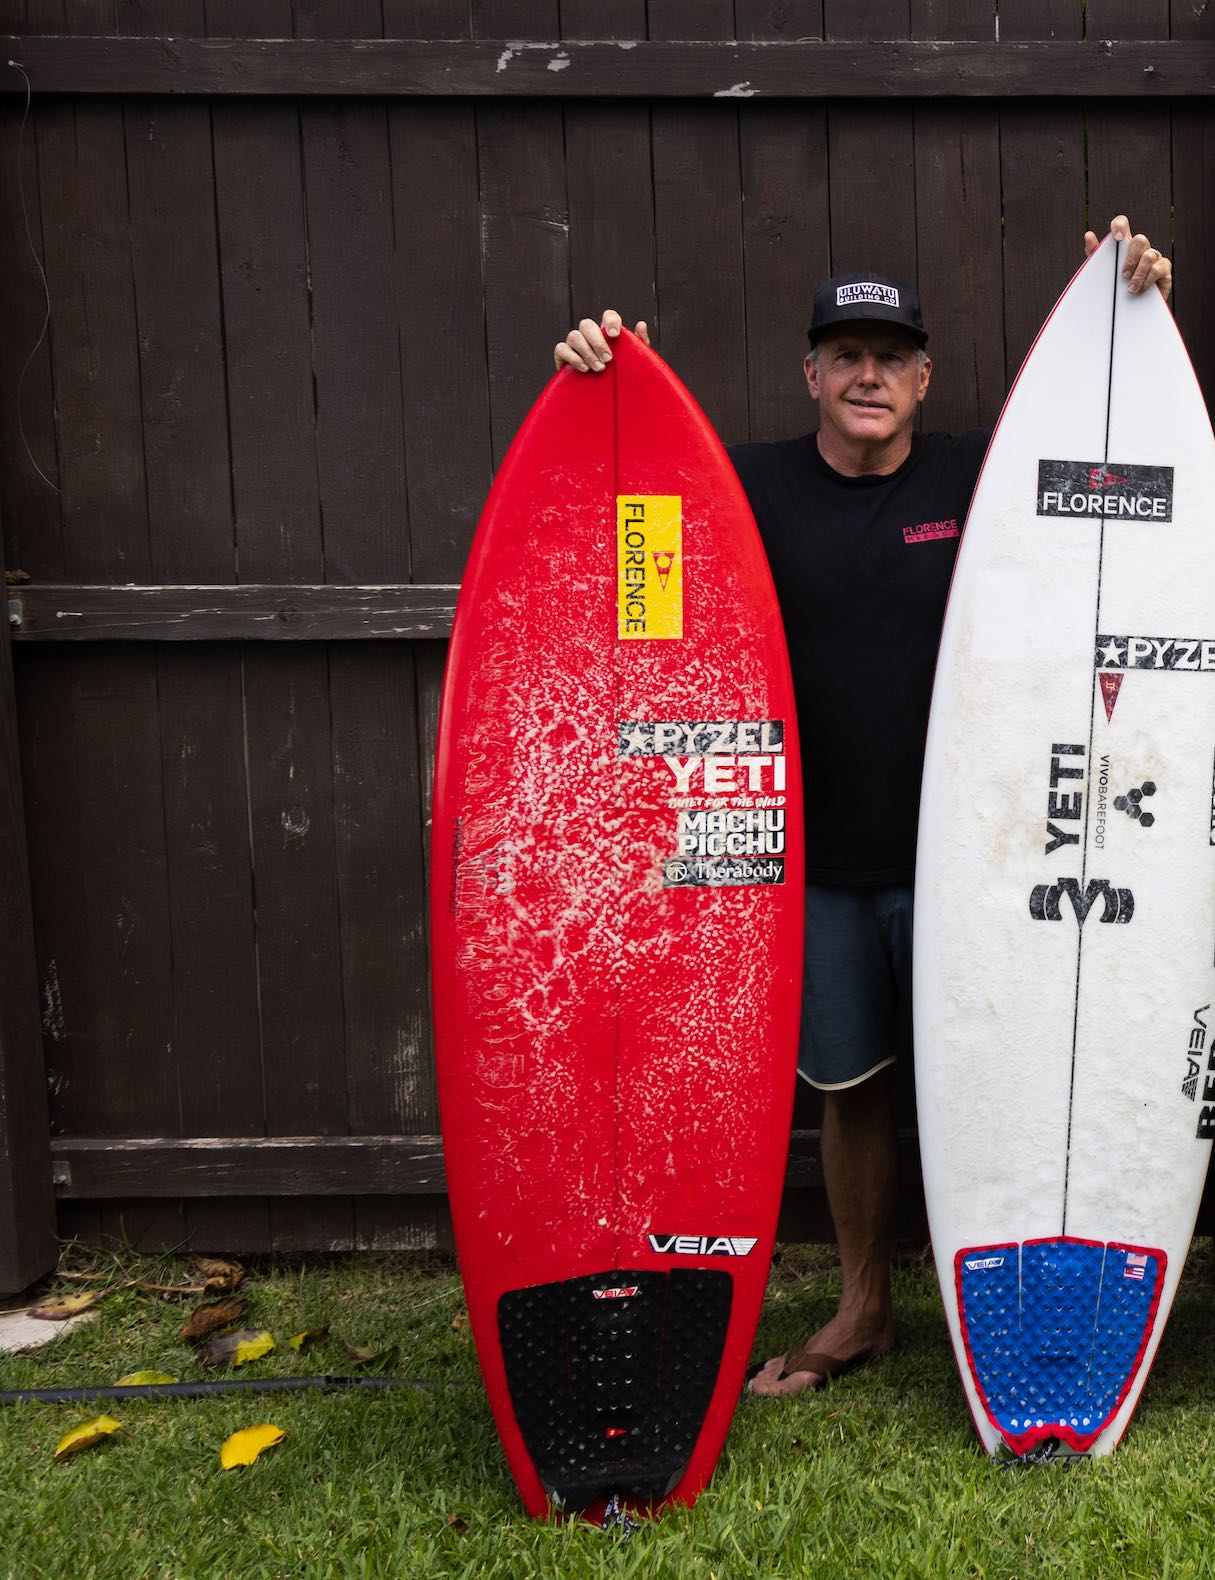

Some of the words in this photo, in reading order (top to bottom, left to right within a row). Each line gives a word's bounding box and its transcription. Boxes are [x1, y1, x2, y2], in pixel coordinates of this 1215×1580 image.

[840, 285, 895, 298] ULUWATU
[840, 294, 880, 303] BUILDING
[1043, 491, 1167, 517] FLORENCE
[903, 520, 958, 536] FLORENCE
[624, 503, 646, 633] FLORENCE
[654, 722, 783, 753] PYZEL
[664, 756, 786, 792] YETI
[704, 797, 730, 808] FOR
[730, 796, 754, 808] THE
[755, 796, 786, 808] WILD
[1045, 743, 1086, 855] YETI
[1095, 755, 1110, 851] VIVOBAREFOOT
[680, 809, 785, 833] MACHU
[680, 831, 785, 856] PICCHU
[694, 861, 783, 881] Therabody
[1183, 1004, 1211, 1082] VEIA
[649, 1235, 736, 1256] VEIA
[968, 1260, 998, 1269] VEIA
[594, 1288, 628, 1299] VEIA
